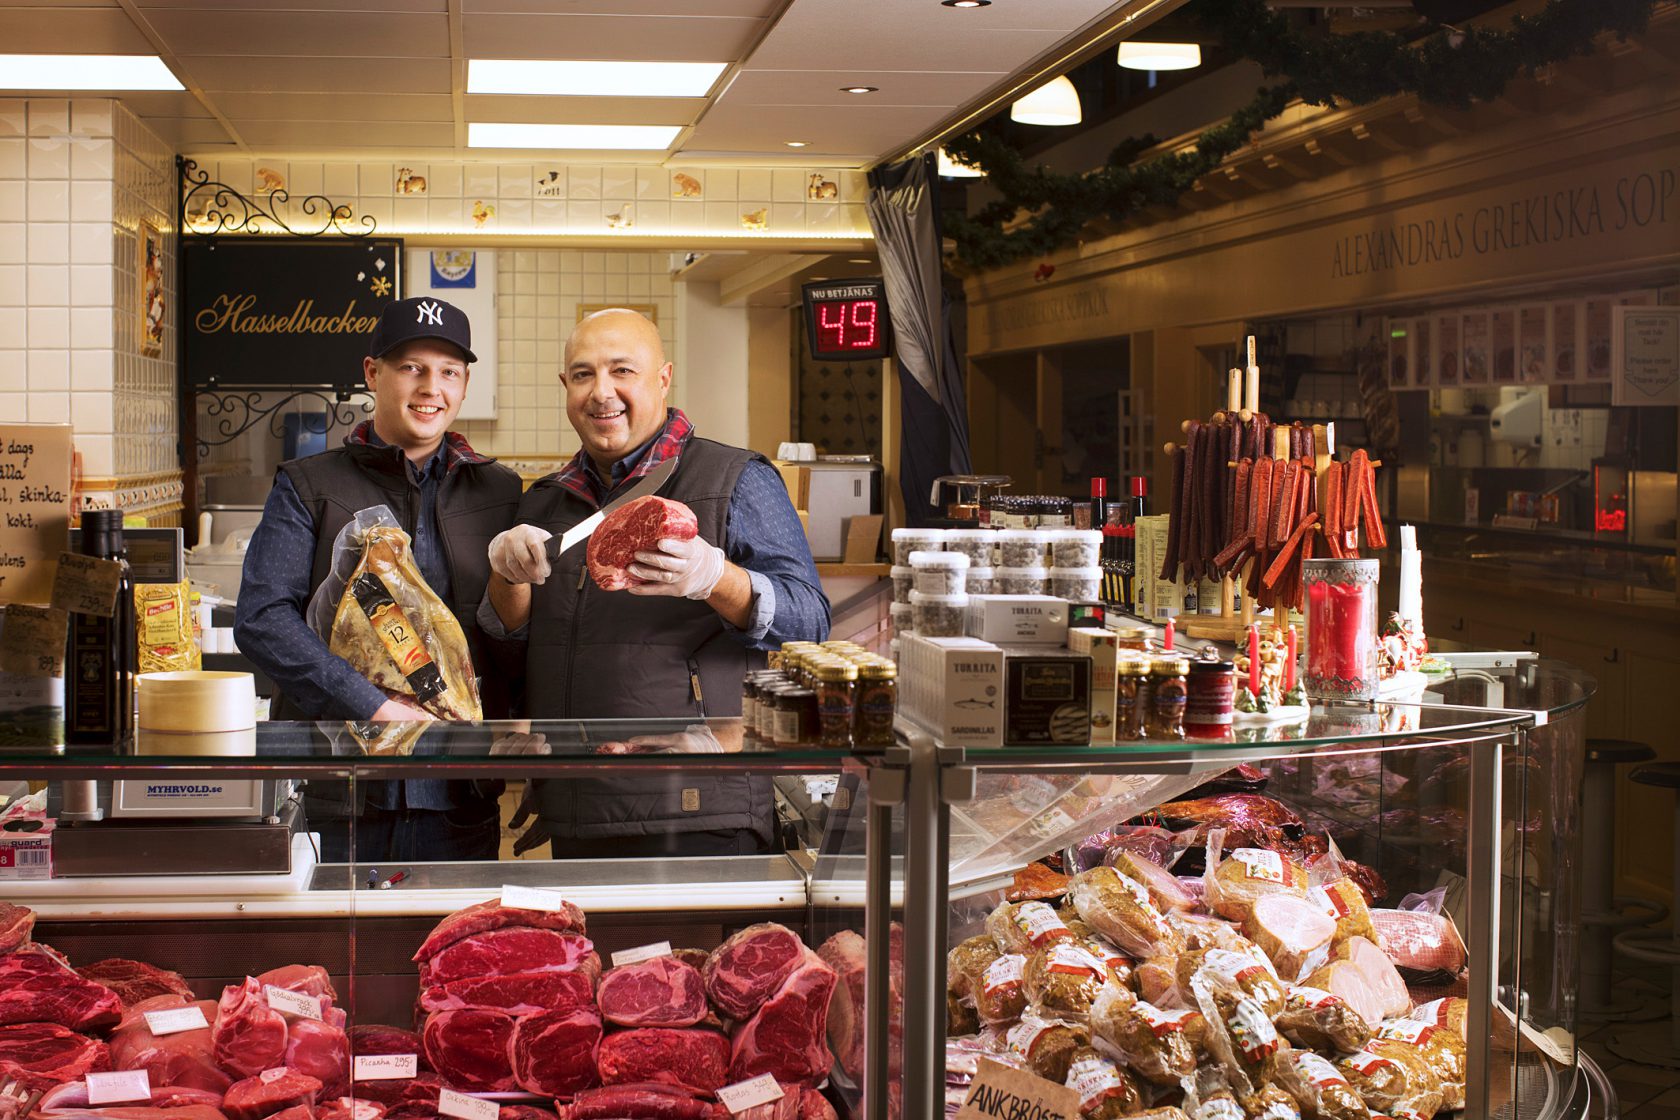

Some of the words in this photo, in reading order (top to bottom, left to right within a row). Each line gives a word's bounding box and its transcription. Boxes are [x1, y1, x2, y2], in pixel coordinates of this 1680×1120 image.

[1331, 212, 1464, 279] ALEXANDRAS
[1471, 186, 1604, 254] GREKISKA
[1615, 169, 1676, 231] SOP
[812, 290, 826, 299] NU
[827, 287, 873, 298] BETJÄNAS
[416, 301, 443, 326] NY
[821, 301, 876, 346] 49
[8, 440, 34, 468] dags
[20, 485, 68, 503] skinka-
[6, 513, 38, 530] kokt,
[388, 626, 409, 644] 12
[953, 663, 997, 673] TURRITA
[147, 785, 223, 794] MYHRVOLD.se
[360, 1057, 391, 1067] Picanha
[967, 1083, 1065, 1120] ANKBRÖ
